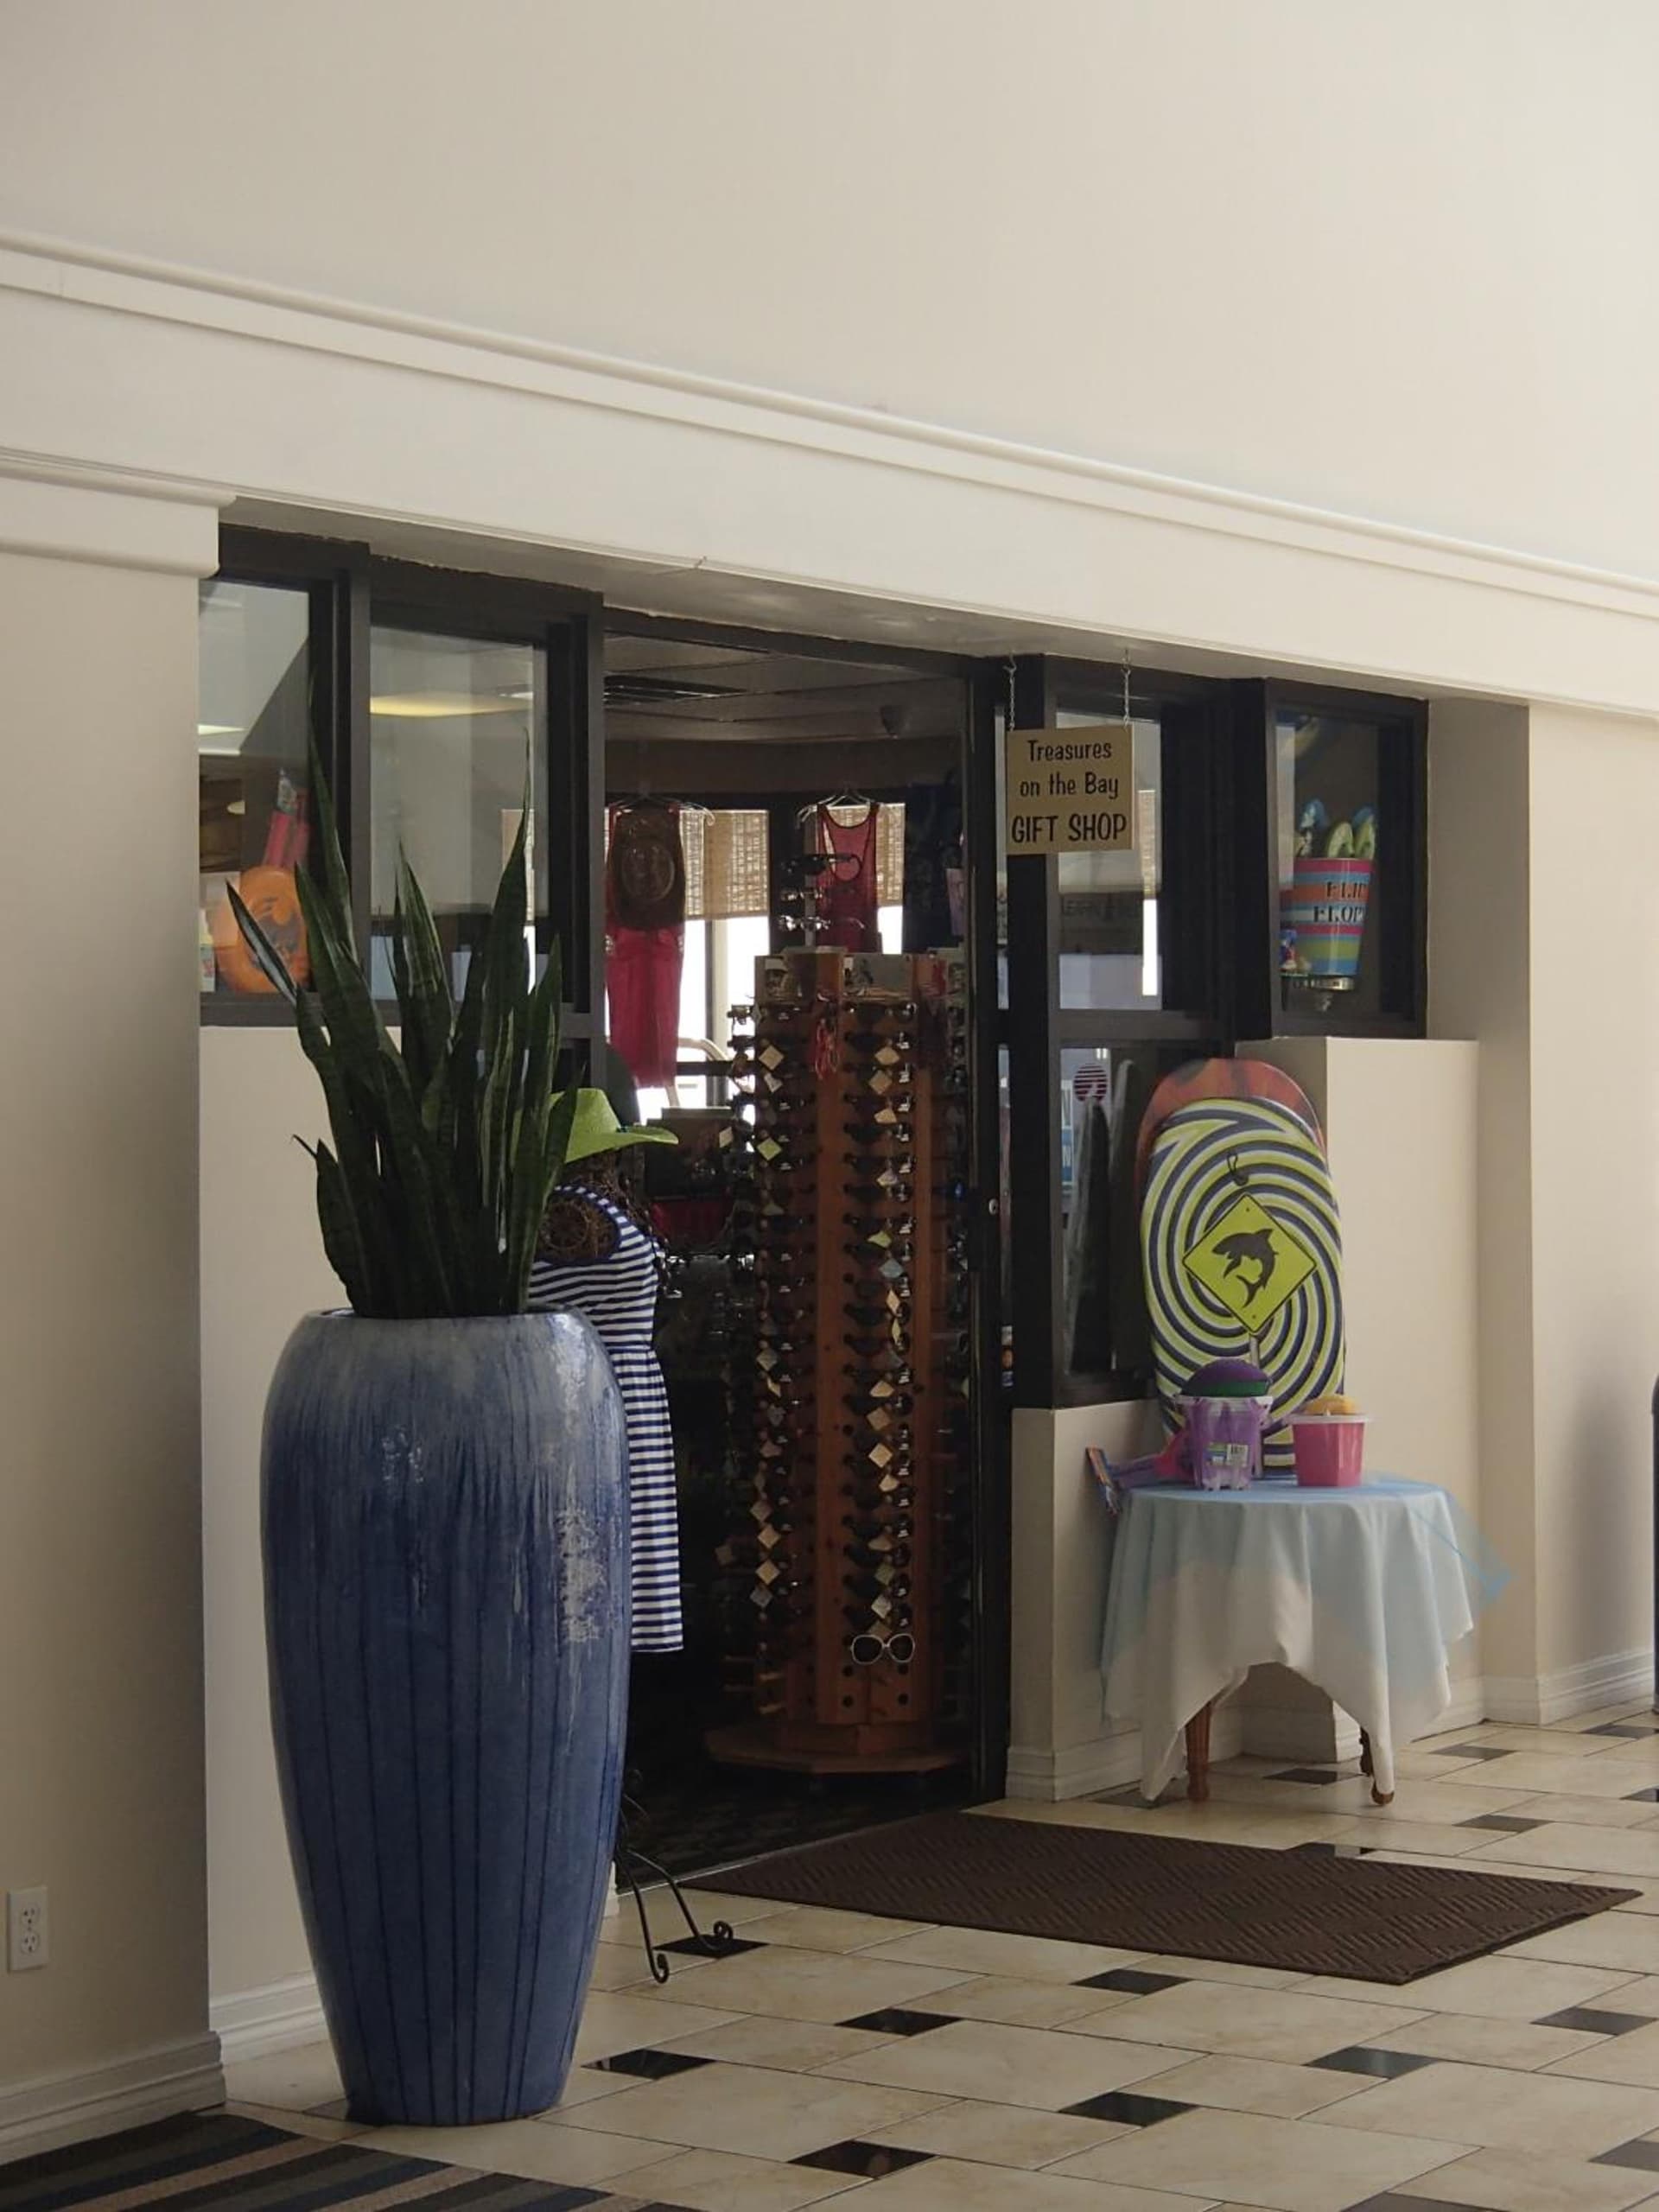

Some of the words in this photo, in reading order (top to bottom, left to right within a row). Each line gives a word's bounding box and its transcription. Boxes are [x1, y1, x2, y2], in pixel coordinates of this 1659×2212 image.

[1027, 739, 1112, 762] Treasures
[1019, 780, 1040, 797] on
[1048, 771, 1077, 796] the
[1084, 771, 1119, 800] Bay
[1011, 814, 1059, 843] GIFT
[1067, 812, 1128, 842] SHOP
